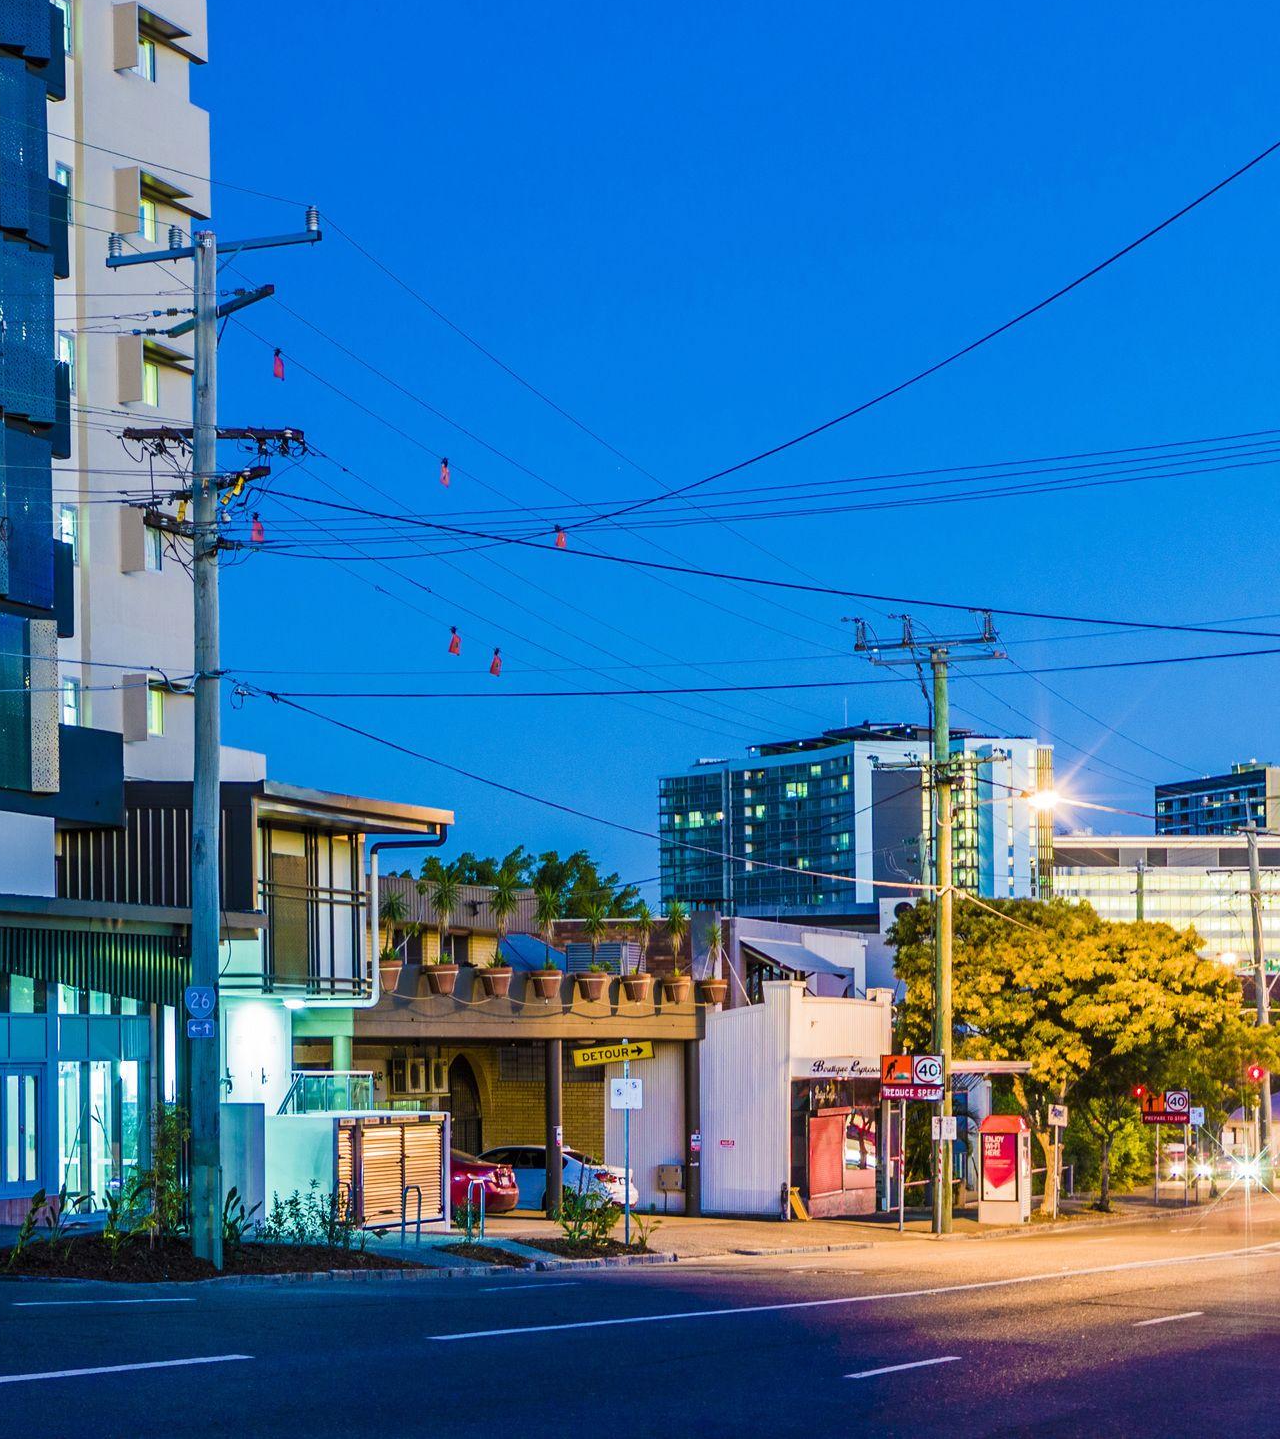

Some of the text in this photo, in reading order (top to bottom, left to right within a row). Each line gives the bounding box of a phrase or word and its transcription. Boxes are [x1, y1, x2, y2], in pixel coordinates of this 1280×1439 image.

[190, 992, 210, 1009] 26
[582, 1048, 629, 1061] DETOUR
[918, 1063, 938, 1077] 40
[885, 1088, 915, 1097] REDUCE
[1170, 1097, 1185, 1107] 40
